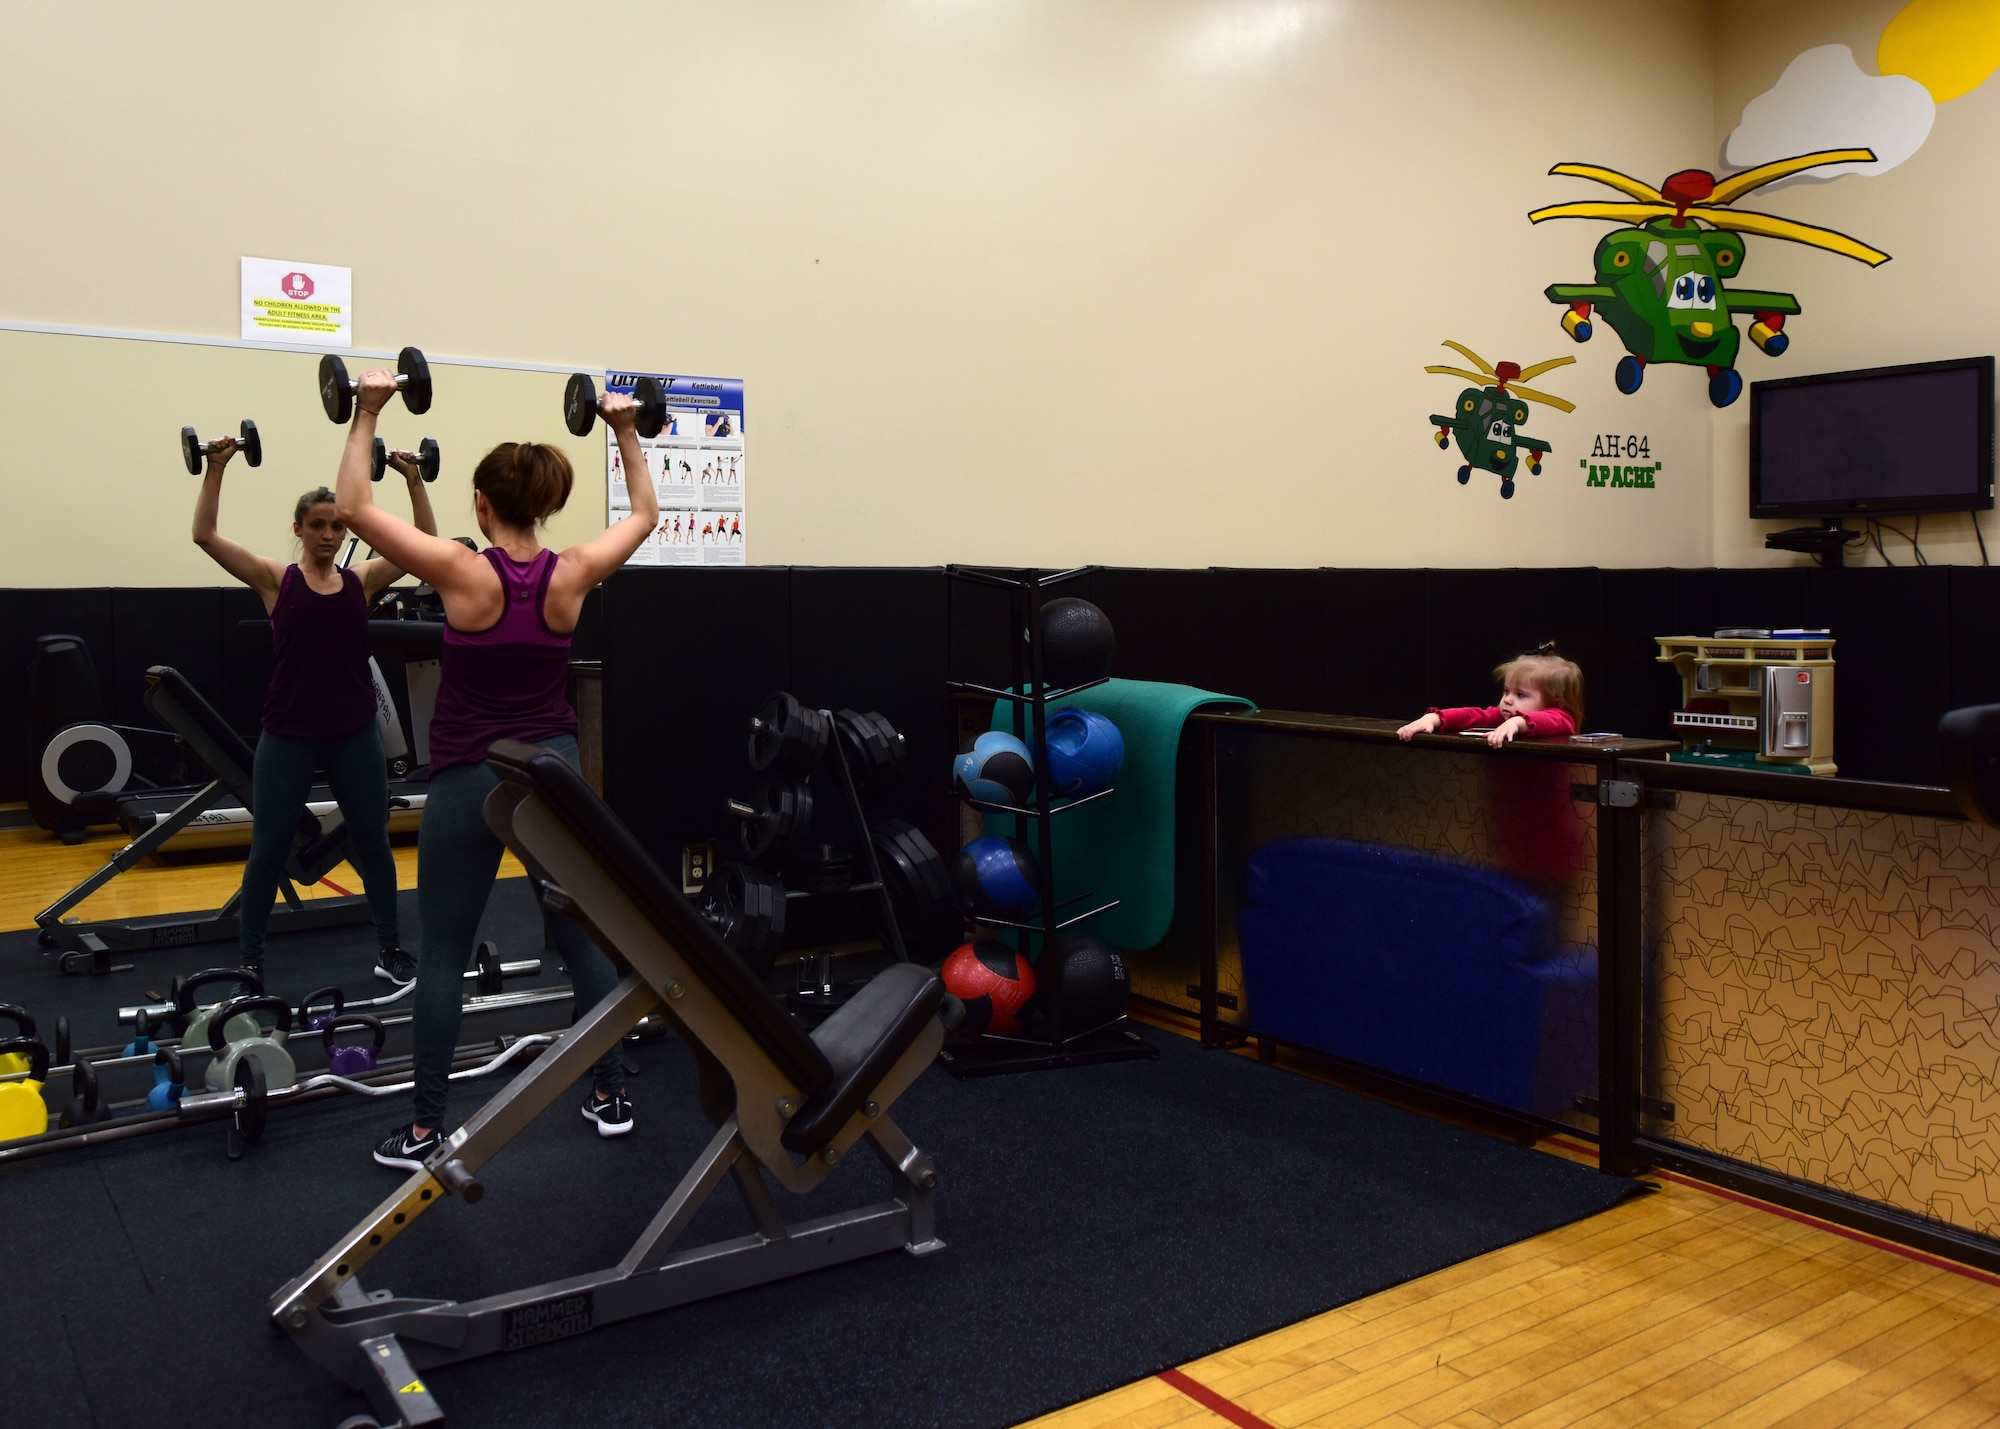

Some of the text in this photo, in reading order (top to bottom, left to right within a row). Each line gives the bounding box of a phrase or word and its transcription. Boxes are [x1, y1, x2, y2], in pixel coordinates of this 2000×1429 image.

[288, 289, 309, 297] STOP
[691, 381, 724, 391] Kettlebell
[690, 397, 718, 405] Exercises
[1591, 434, 1650, 459] AH-64
[1580, 459, 1662, 488] "APACHE"
[511, 1295, 587, 1328] HAMMER
[507, 1312, 590, 1348] STRENGTH
